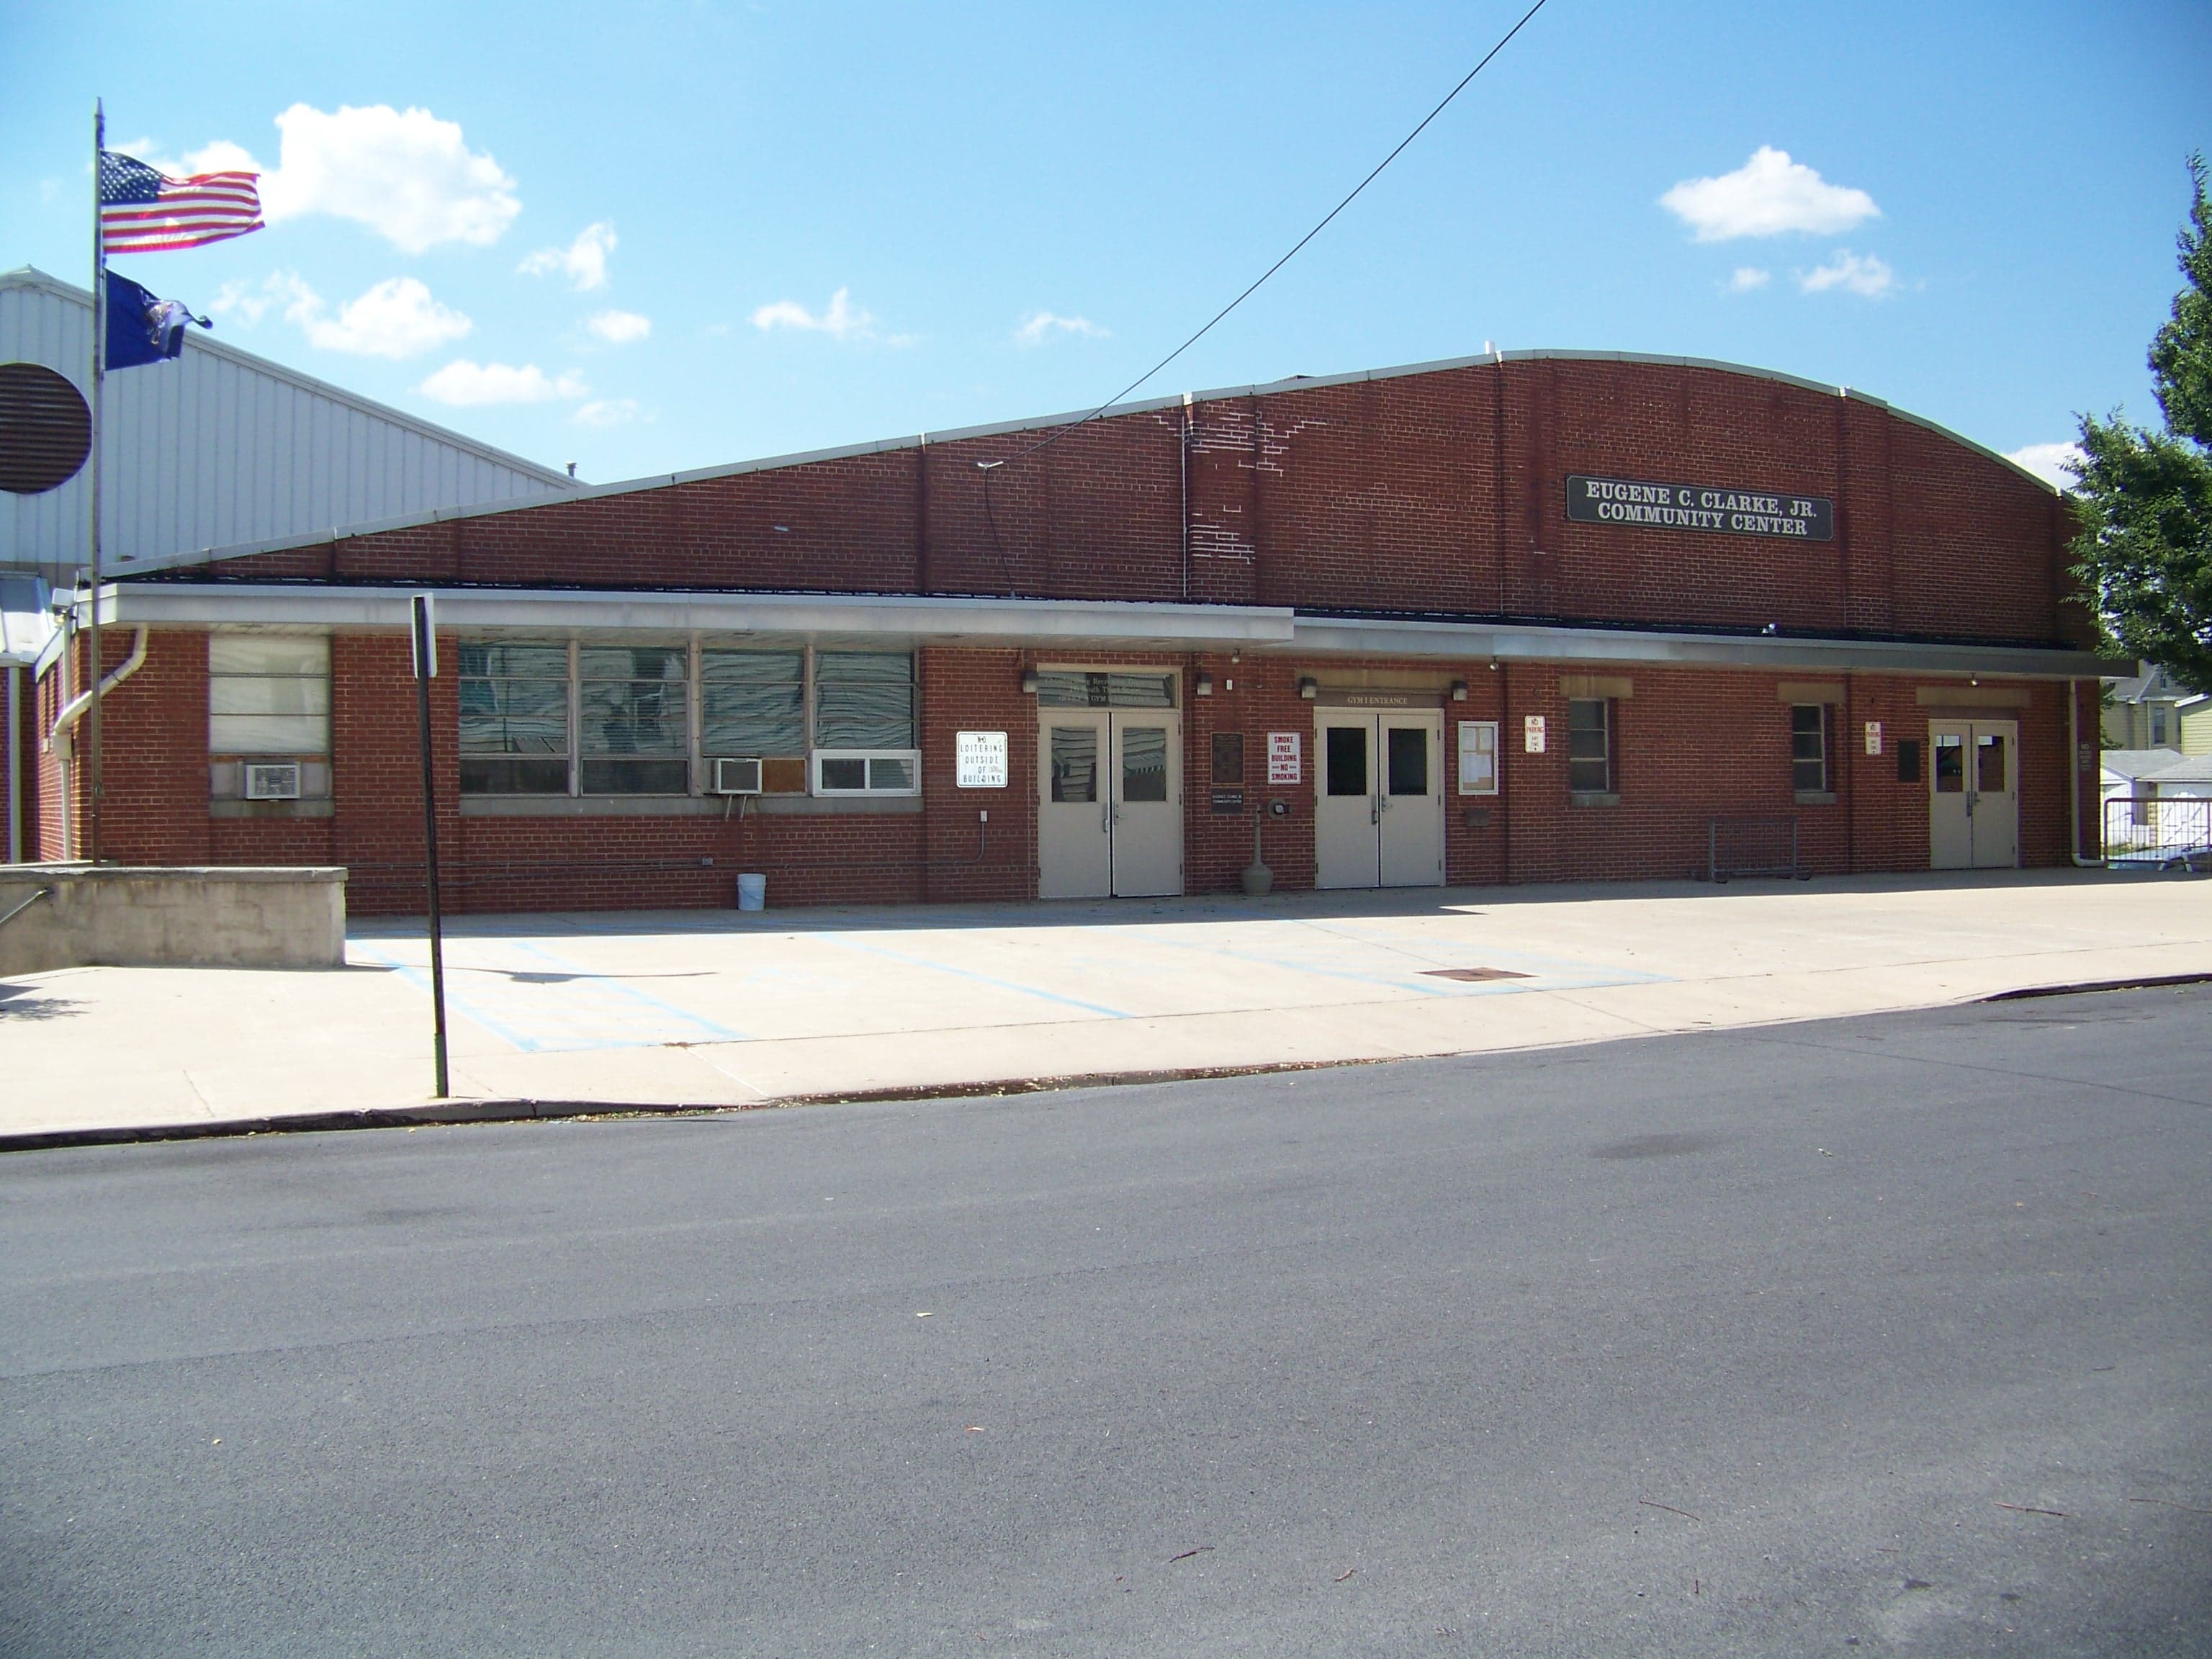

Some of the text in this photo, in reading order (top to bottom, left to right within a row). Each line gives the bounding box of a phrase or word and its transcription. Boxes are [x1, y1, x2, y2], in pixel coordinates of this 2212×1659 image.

[1586, 481, 1817, 518] EUGENE C. CLARKE, JR.
[1598, 503, 1807, 535] COMMUNITY CENTER
[960, 744, 1003, 752] LOITERING
[965, 755, 999, 764] OUTSIDE
